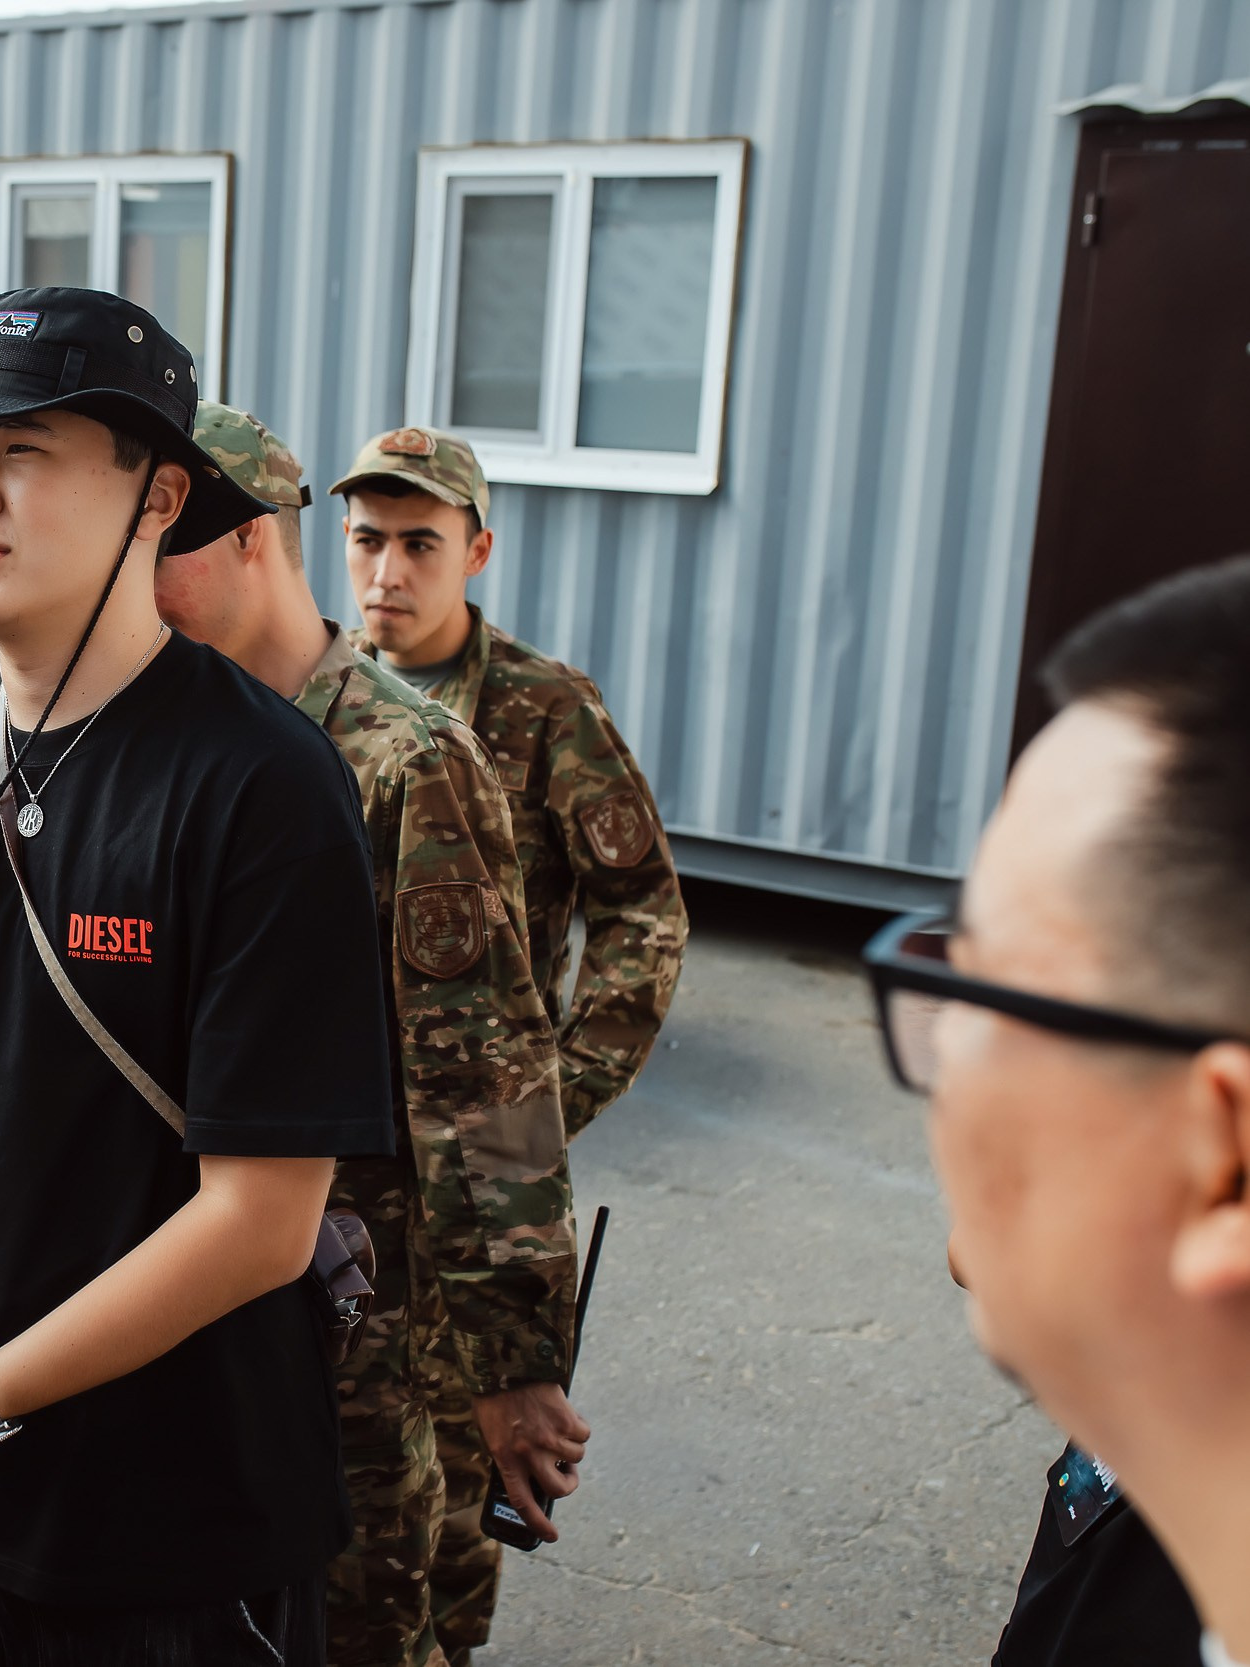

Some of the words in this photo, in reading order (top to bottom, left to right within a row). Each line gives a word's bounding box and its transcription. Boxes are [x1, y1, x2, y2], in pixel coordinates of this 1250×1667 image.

[68, 913, 152, 955] DIESEL
[68, 950, 81, 958] FOR
[82, 952, 128, 962] SUCCESSFUL
[129, 955, 152, 964] LIVING
